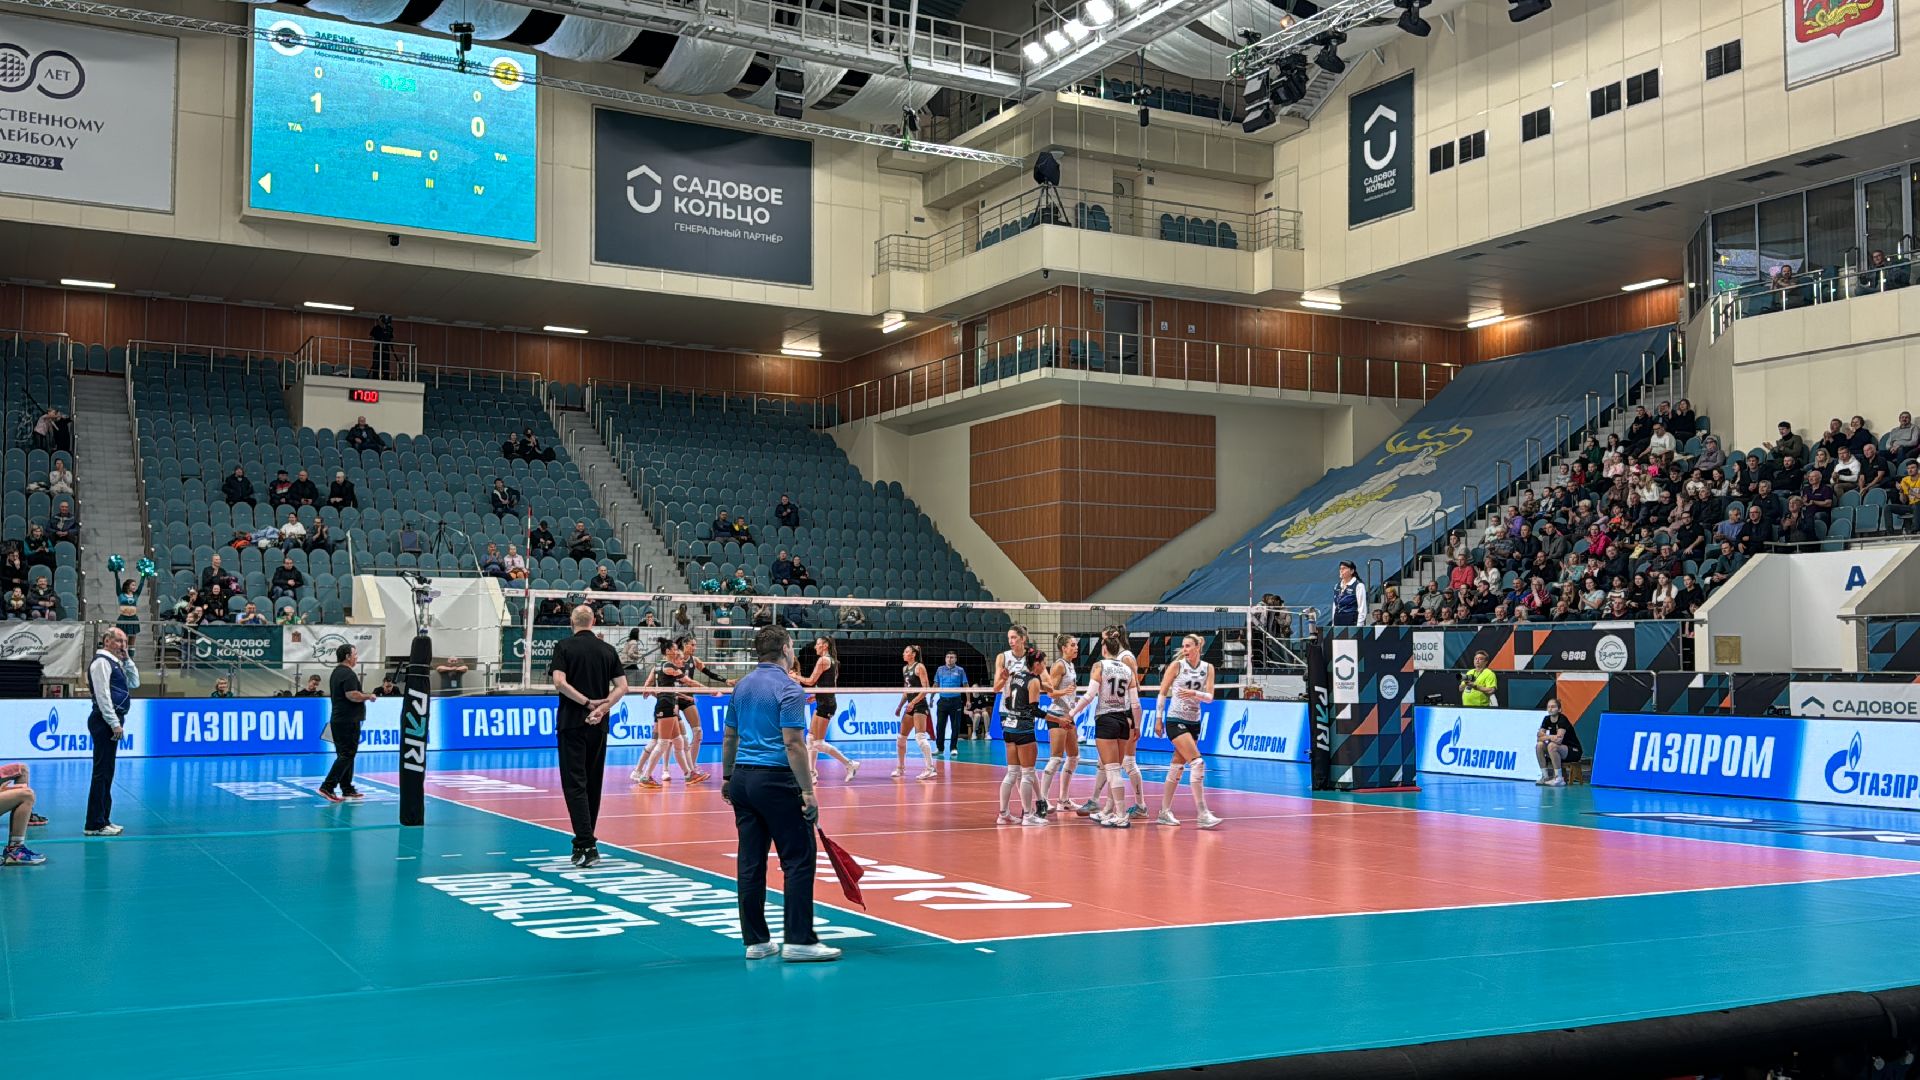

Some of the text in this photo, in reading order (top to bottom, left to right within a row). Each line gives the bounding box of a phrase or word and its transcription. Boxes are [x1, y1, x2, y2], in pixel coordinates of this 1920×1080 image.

[44, 68, 71, 82] ЛЕТ
[314, 66, 323, 79] 0
[310, 92, 322, 114] 1
[472, 90, 482, 103] 0
[0, 107, 104, 134] СТВЕННОМУ
[470, 116, 486, 138] 0
[365, 139, 375, 152] 0
[429, 149, 438, 162] 0
[672, 174, 784, 205] САДОВОЕ
[674, 196, 771, 226] КОЛЬЦО
[674, 222, 741, 239] ГЕНЕРАЛЬНЫЙ
[216, 638, 271, 648] САДОВОЕ
[216, 648, 265, 657] КОЛЬЦО
[1107, 677, 1128, 698] 15
[1314, 685, 1330, 752] PARI
[1832, 699, 1918, 716] САДОВОЕ
[171, 710, 304, 743] ГАЗПРОМ
[404, 687, 428, 773] PARI
[462, 707, 558, 737] ГАЗПРО
[60, 734, 134, 751] ГАЗМ
[1244, 734, 1287, 753] ГАЗПРОМ
[1457, 746, 1517, 771] ГАЗПРОМ
[1629, 731, 1776, 779] ГАЗПРОМ
[1859, 771, 1920, 799] ГАЗПР
[417, 871, 660, 939] ОБЛАСТЬ
